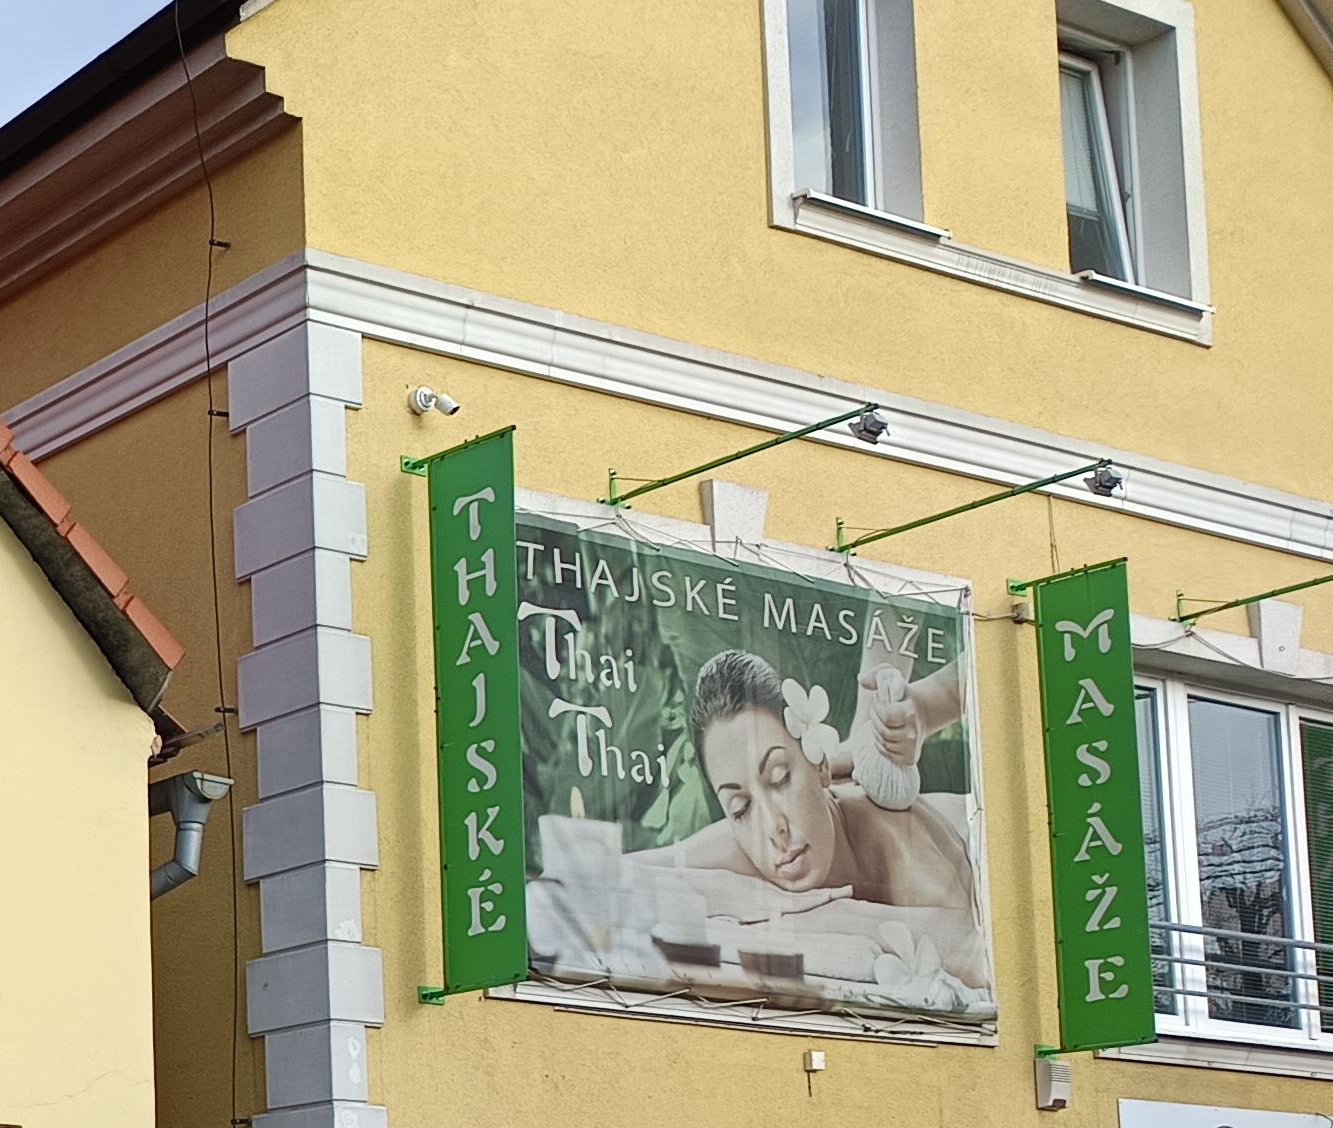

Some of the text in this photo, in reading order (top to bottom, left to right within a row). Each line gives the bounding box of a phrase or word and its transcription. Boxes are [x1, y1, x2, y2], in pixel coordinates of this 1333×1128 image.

[516, 540, 948, 664] THAJSKÉ MASÁŽE
[517, 601, 637, 693] Thai
[452, 485, 506, 939] THAJSKÉ
[548, 698, 670, 788] Thai
[1055, 608, 1130, 1004] MASÁŽE
